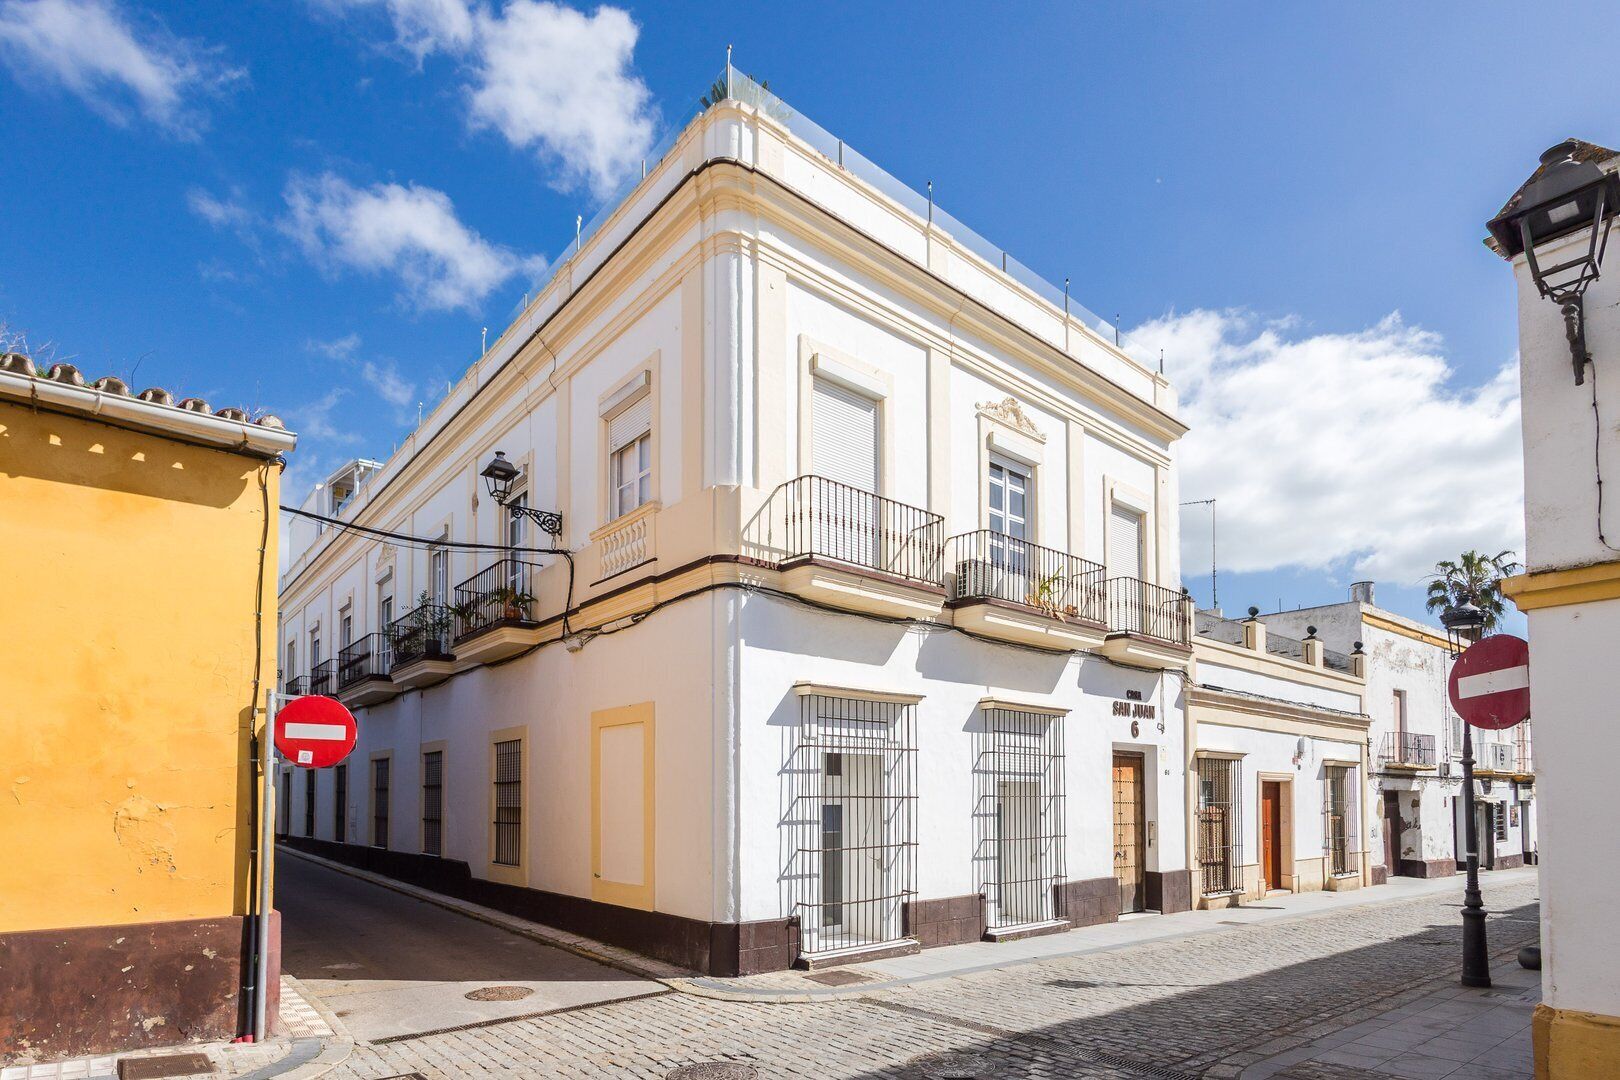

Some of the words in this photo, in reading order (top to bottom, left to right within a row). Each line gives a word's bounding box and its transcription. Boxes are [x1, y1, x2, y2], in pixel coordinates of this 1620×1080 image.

[1112, 700, 1131, 717] SAN
[1132, 704, 1156, 720] JUAN
[1130, 720, 1140, 739] 6
